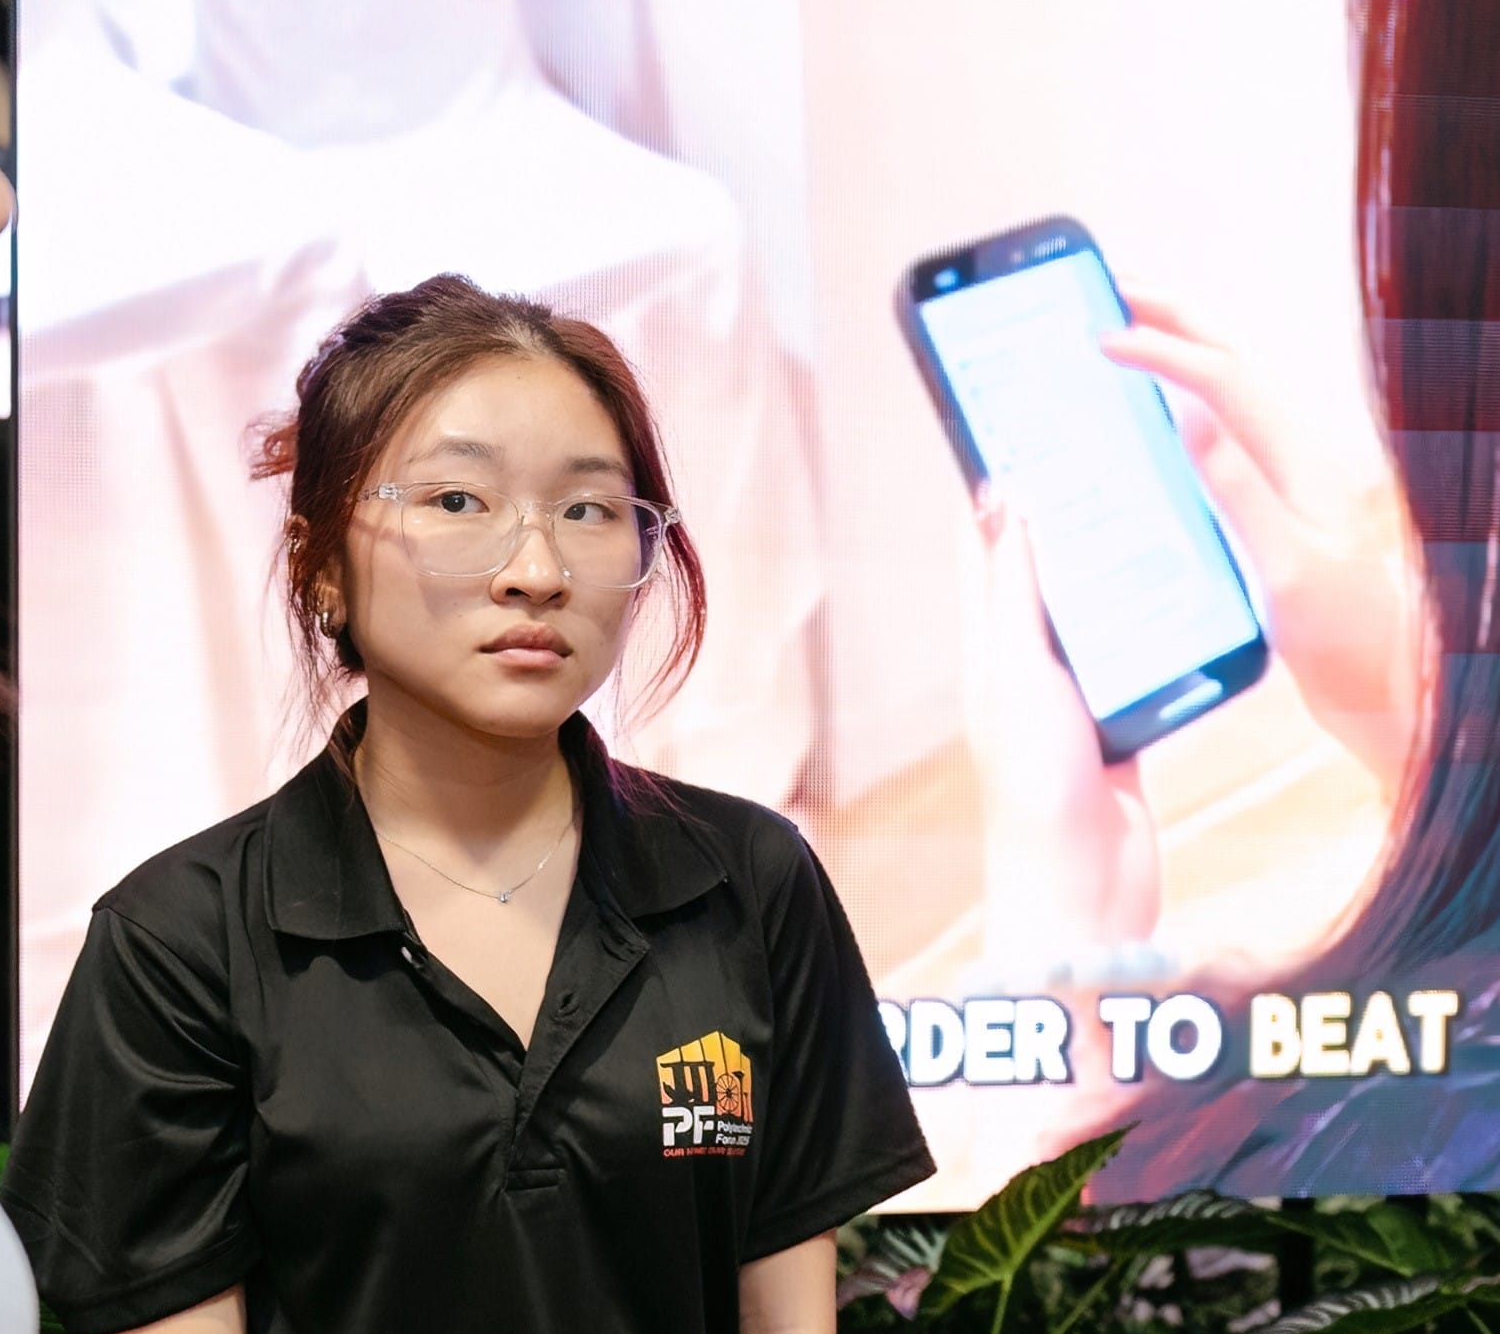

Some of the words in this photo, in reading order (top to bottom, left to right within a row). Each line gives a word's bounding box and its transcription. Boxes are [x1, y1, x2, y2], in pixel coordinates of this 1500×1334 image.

[1099, 993, 1223, 1081] TO
[1248, 989, 1459, 1079] BEAT
[662, 1105, 715, 1147] PF
